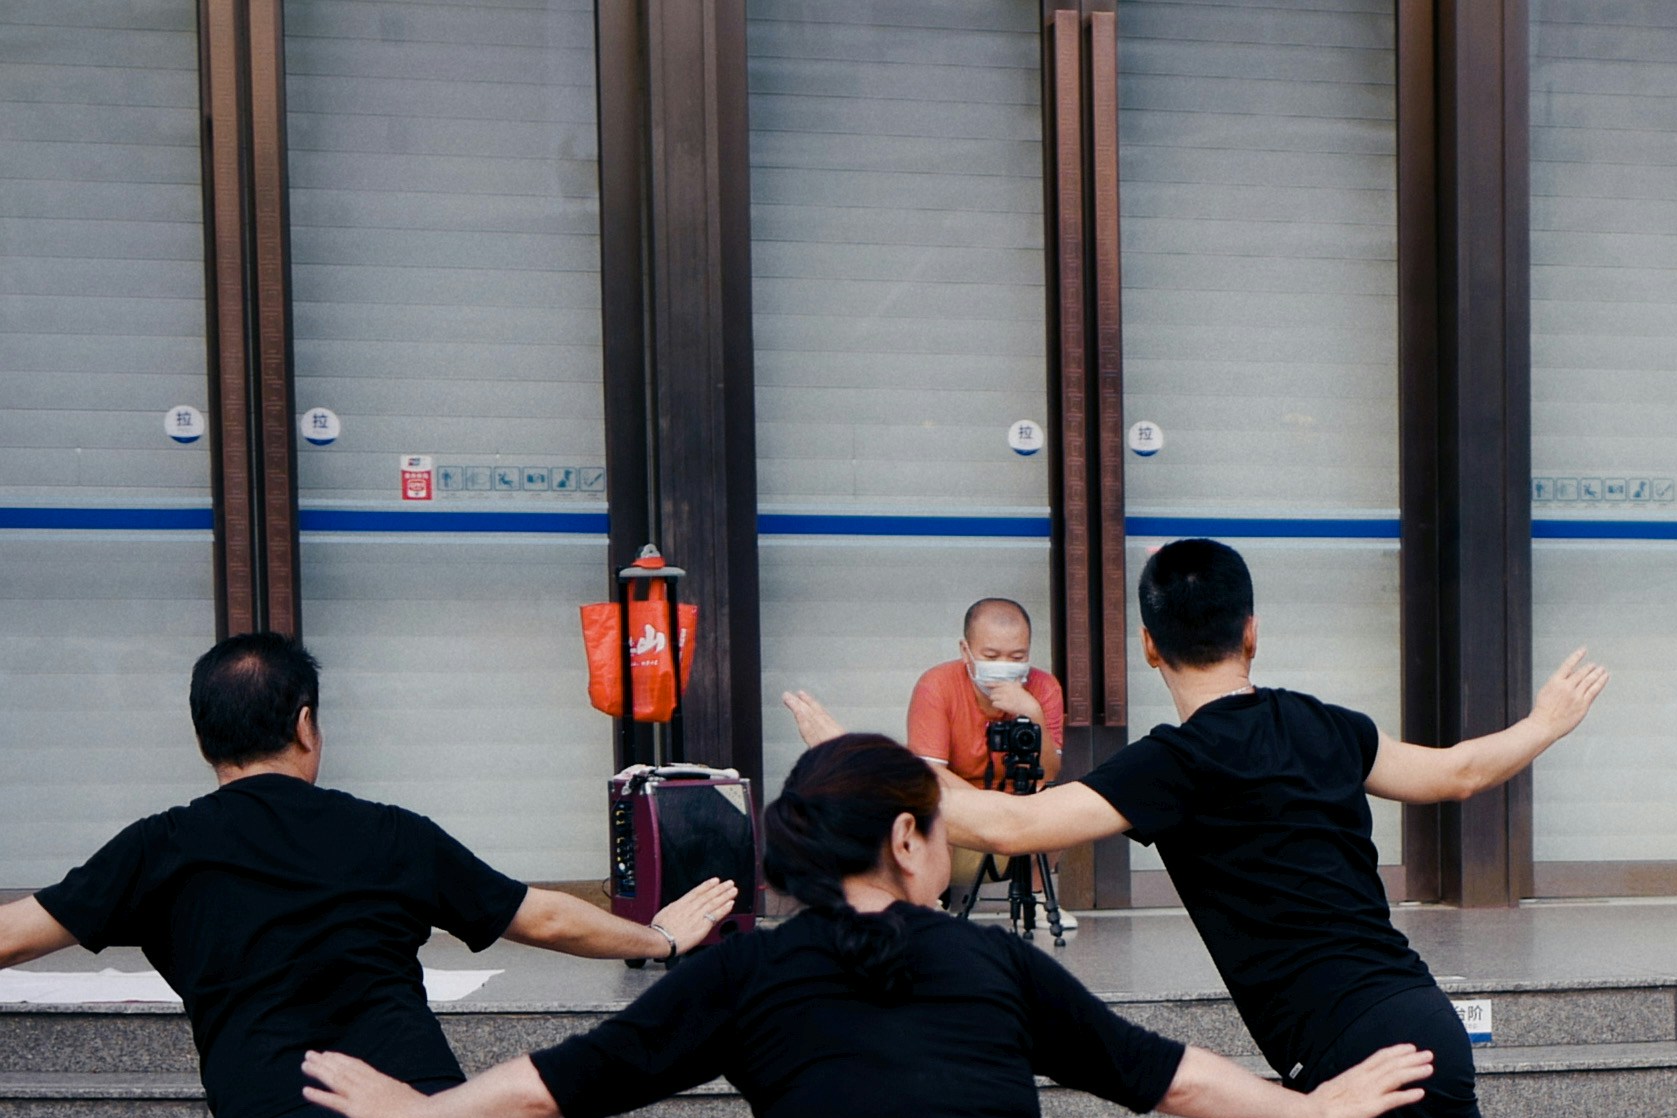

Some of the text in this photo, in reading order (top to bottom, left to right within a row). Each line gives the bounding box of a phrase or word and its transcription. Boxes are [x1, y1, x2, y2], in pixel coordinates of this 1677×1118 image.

[176, 412, 192, 427] 拉
[313, 413, 329, 428] 拉
[1018, 425, 1034, 440] 拉
[1138, 426, 1153, 441] 拉
